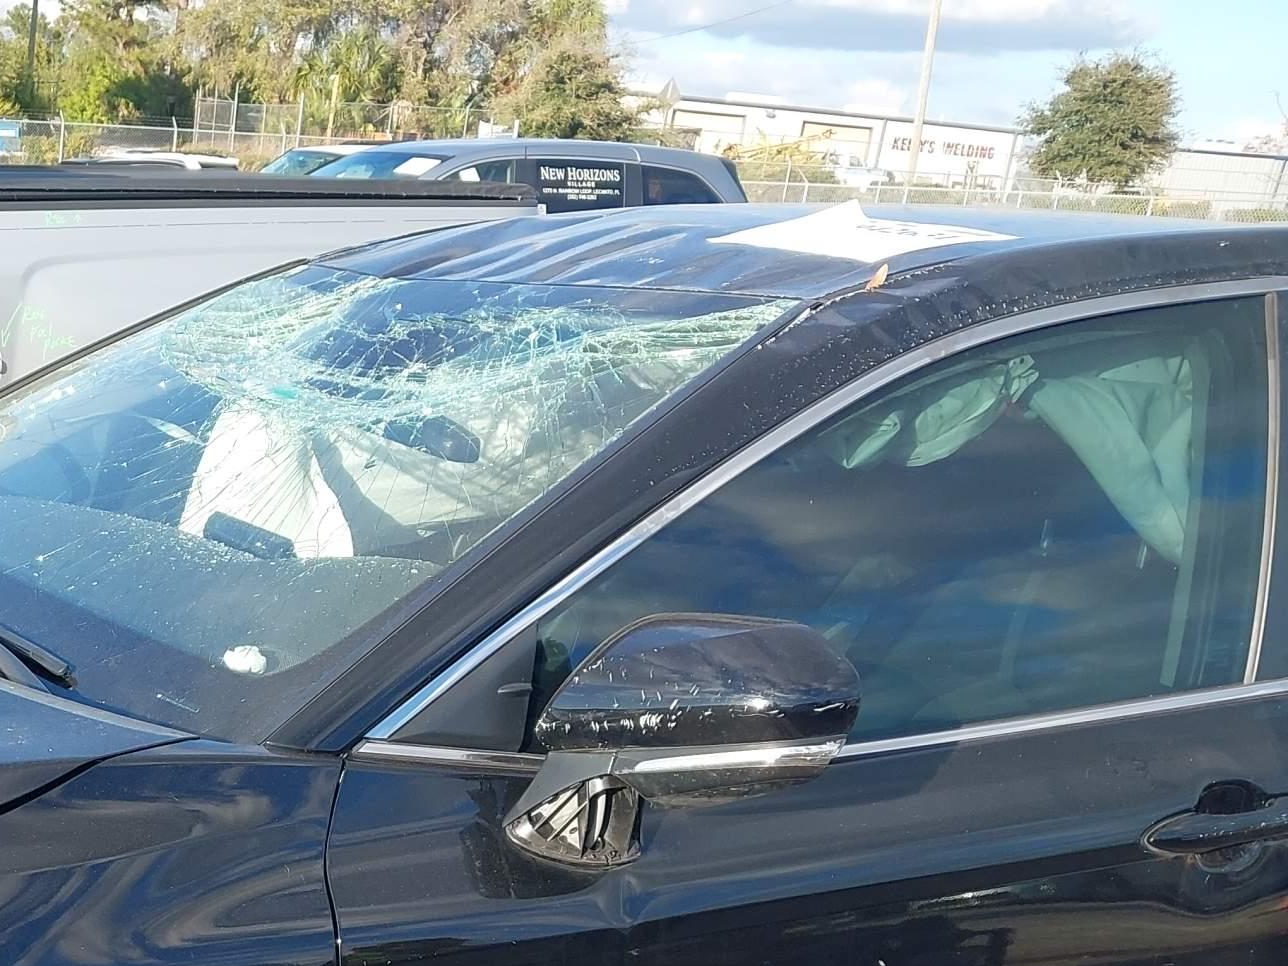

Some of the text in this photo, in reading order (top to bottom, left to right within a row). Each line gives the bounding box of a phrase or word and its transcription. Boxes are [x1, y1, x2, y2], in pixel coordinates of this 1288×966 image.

[891, 136, 995, 159] KELY'S WELDING
[540, 166, 621, 181] NEW HORIZONS
